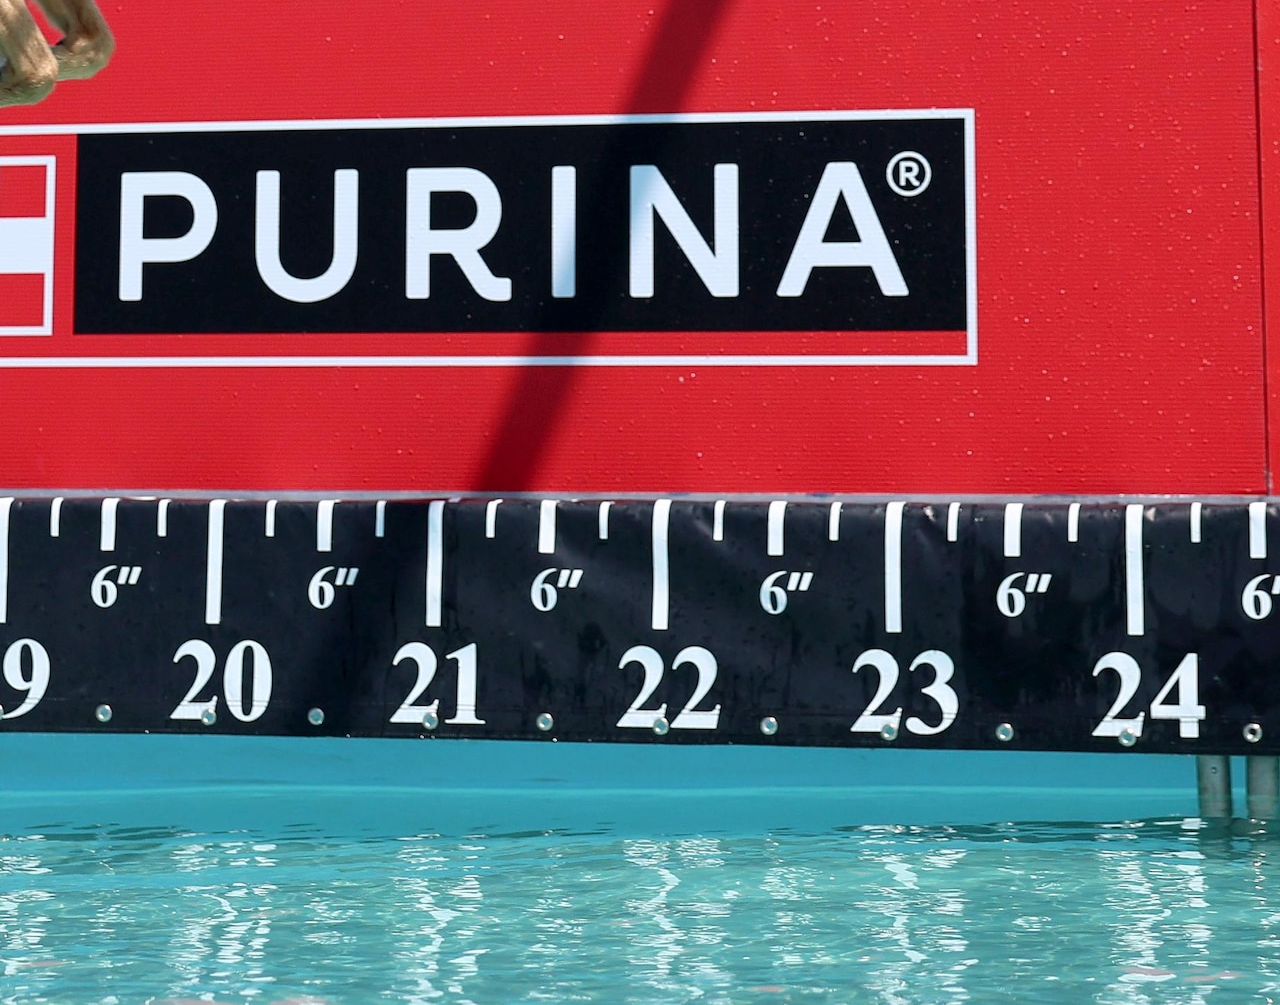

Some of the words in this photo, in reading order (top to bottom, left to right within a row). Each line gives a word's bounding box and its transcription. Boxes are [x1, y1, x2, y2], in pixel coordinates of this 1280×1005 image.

[170, 640, 272, 722] 20
[390, 642, 485, 725] 21
[617, 646, 721, 730] 22
[851, 649, 958, 735] 23
[1091, 652, 1206, 738] 24
